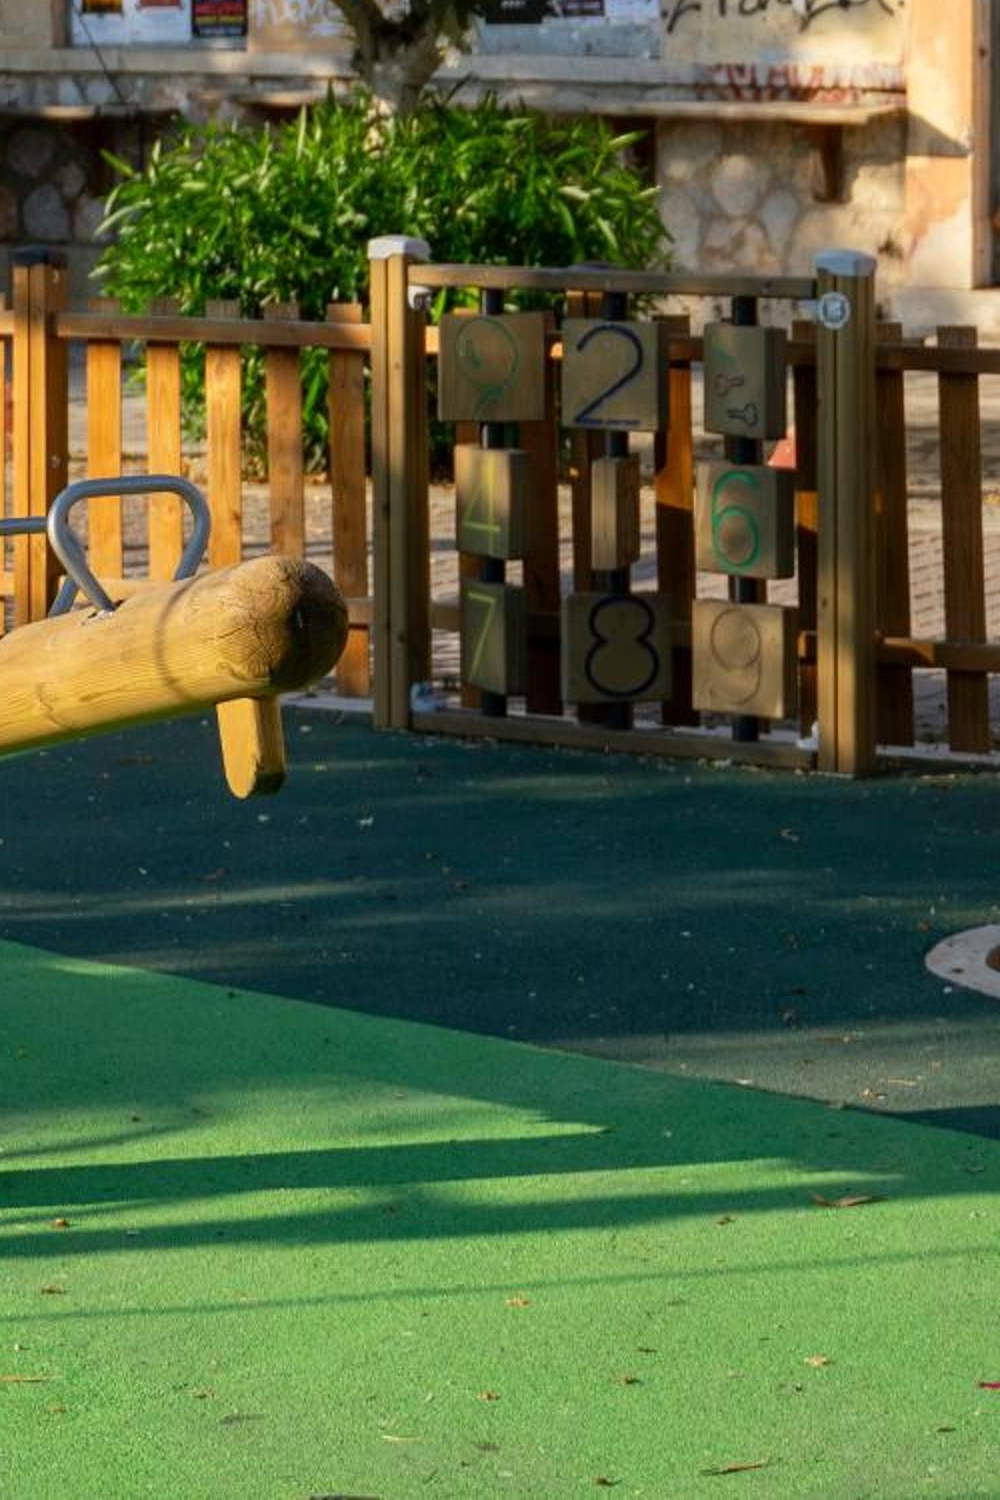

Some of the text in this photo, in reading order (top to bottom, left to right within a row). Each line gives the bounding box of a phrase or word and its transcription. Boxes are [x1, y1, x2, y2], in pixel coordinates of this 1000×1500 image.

[574, 324, 644, 425] 2
[463, 451, 501, 554] 4
[710, 470, 760, 573] 6
[467, 591, 497, 682] 7
[585, 593, 660, 697] 8
[710, 608, 762, 705] 9
